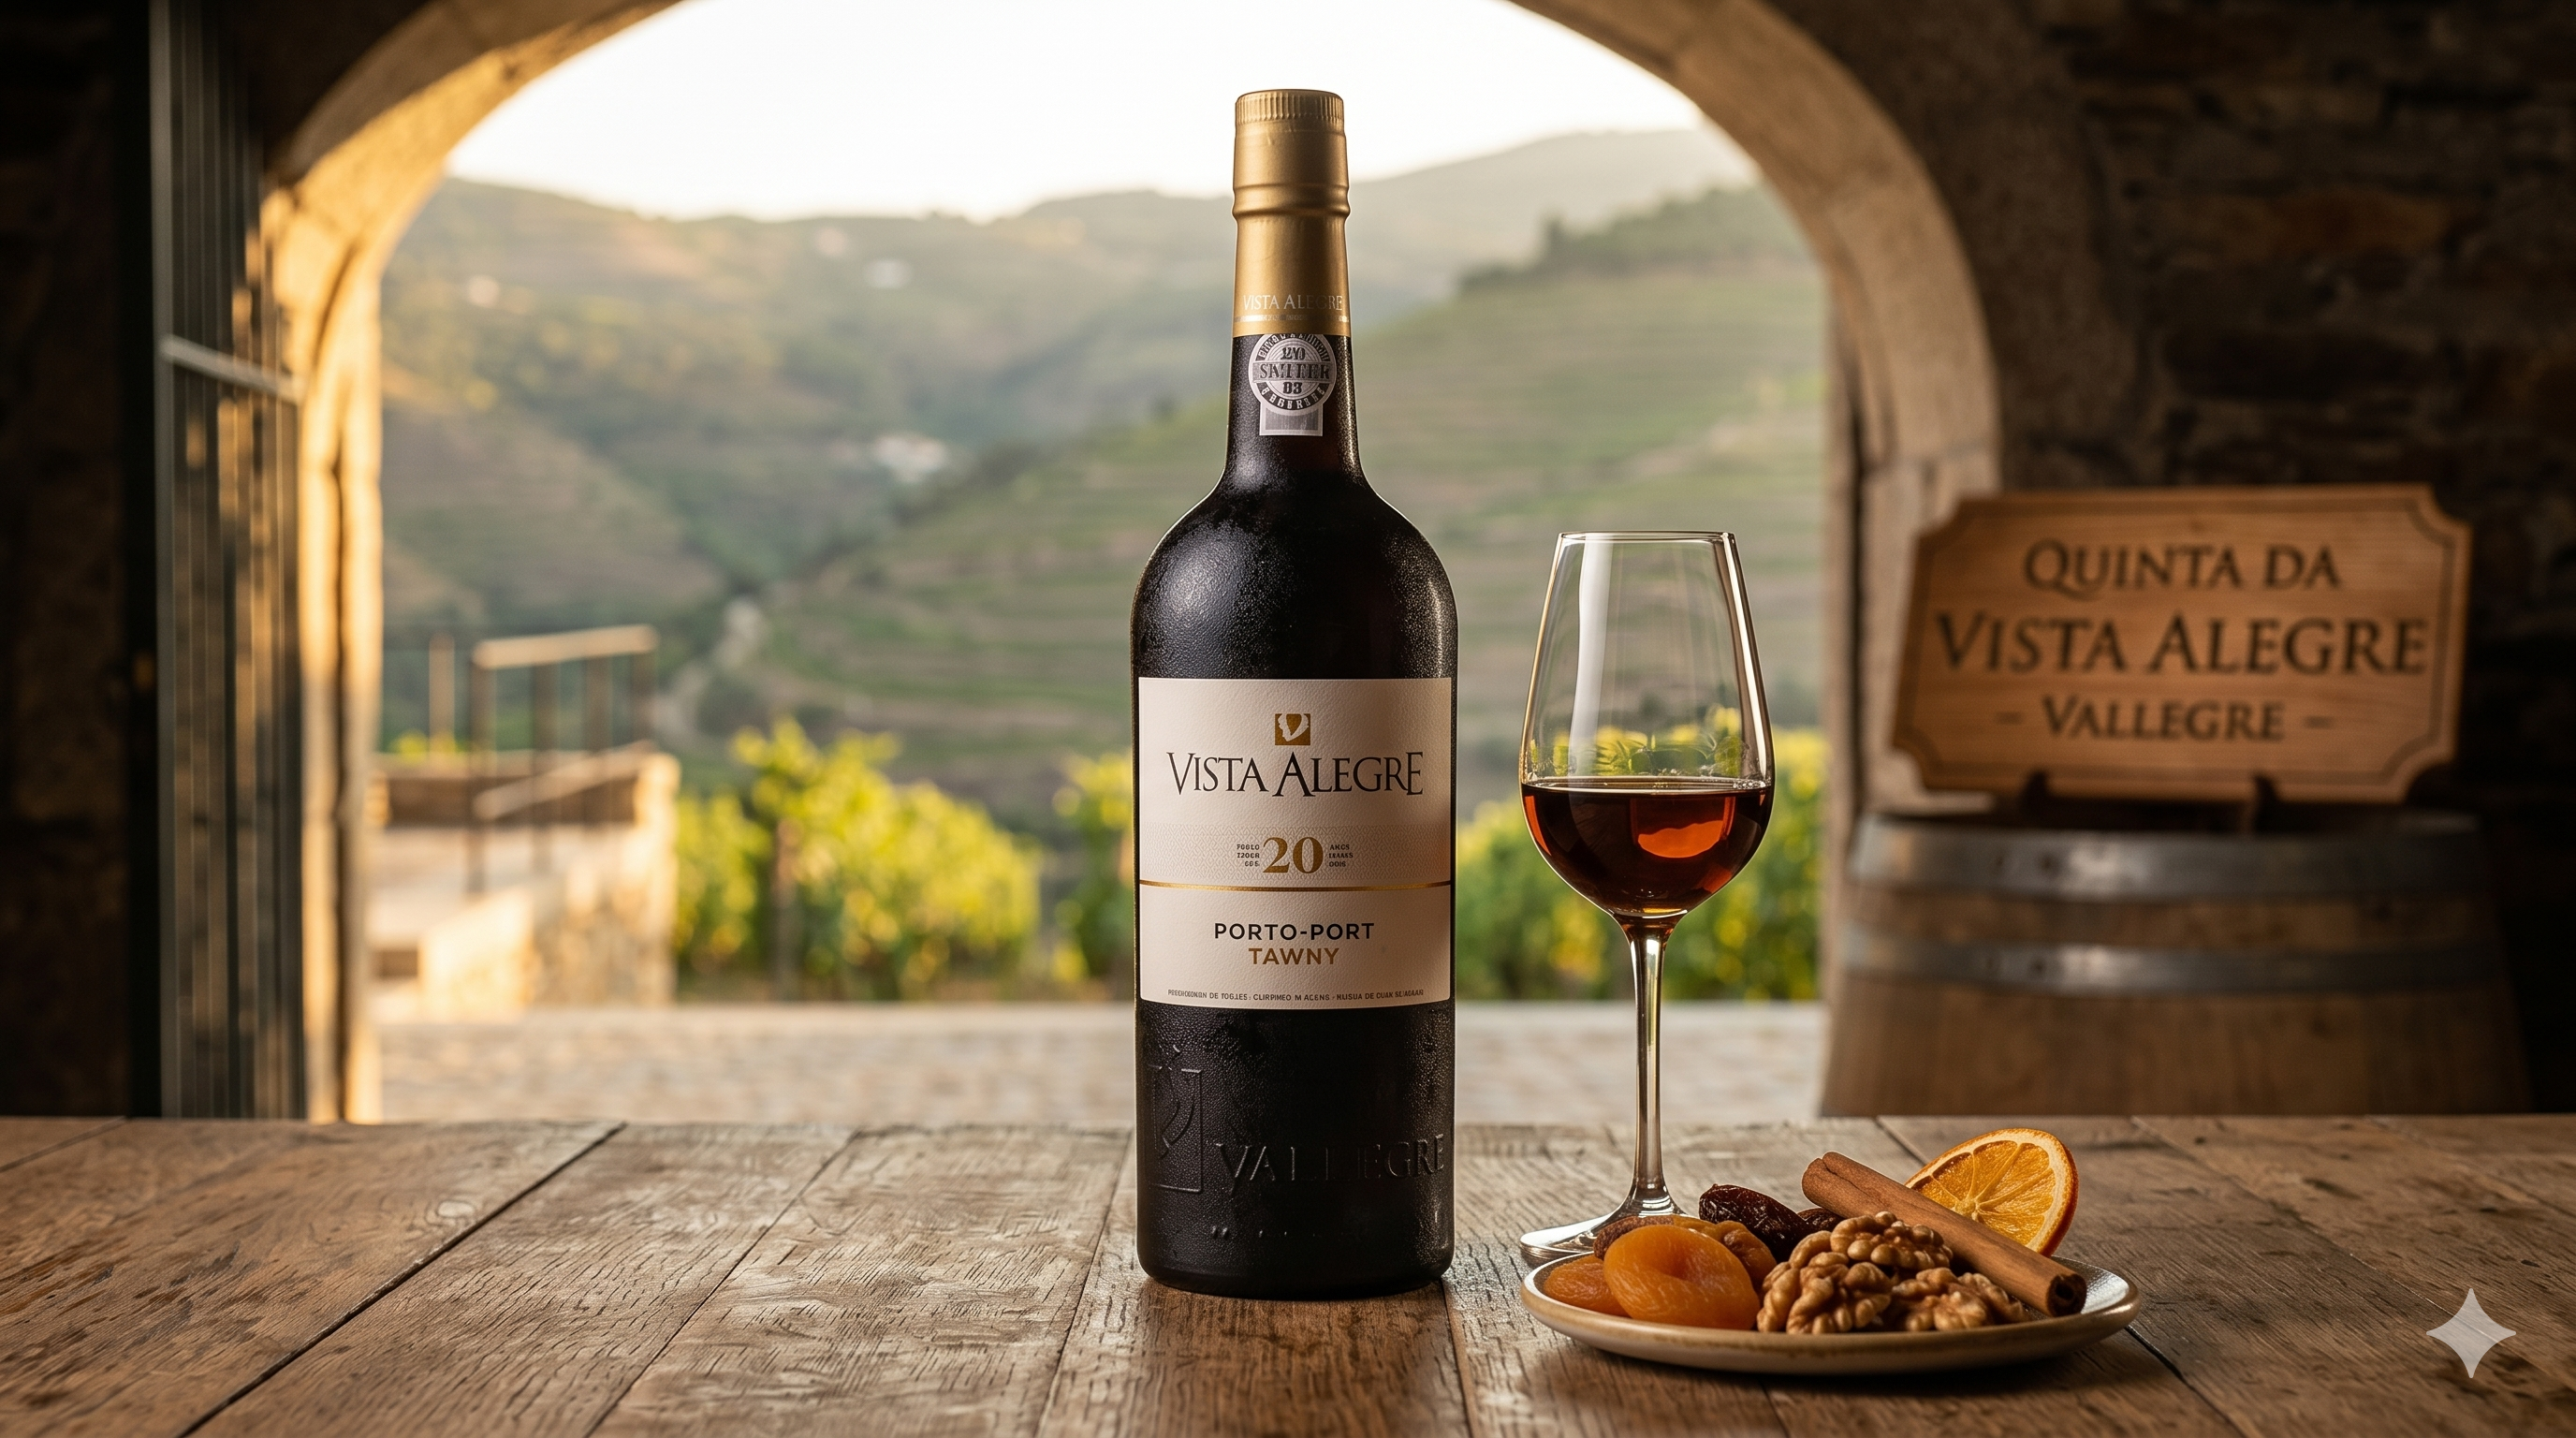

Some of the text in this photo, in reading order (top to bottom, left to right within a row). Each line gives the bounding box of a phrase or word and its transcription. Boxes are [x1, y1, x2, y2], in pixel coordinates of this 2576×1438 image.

[1243, 294, 1343, 311] VISTA ALEGRE
[2022, 538, 2342, 602] QUINTA DA
[1934, 609, 2430, 677] VISTA ALEGRE
[2041, 694, 2287, 742] VALLEGRE
[1166, 751, 1424, 797] VISTA ALEGRE
[1263, 836, 1325, 874] 20
[1214, 922, 1375, 941] PORTO-PORT
[1248, 947, 1339, 965] TAWNY
